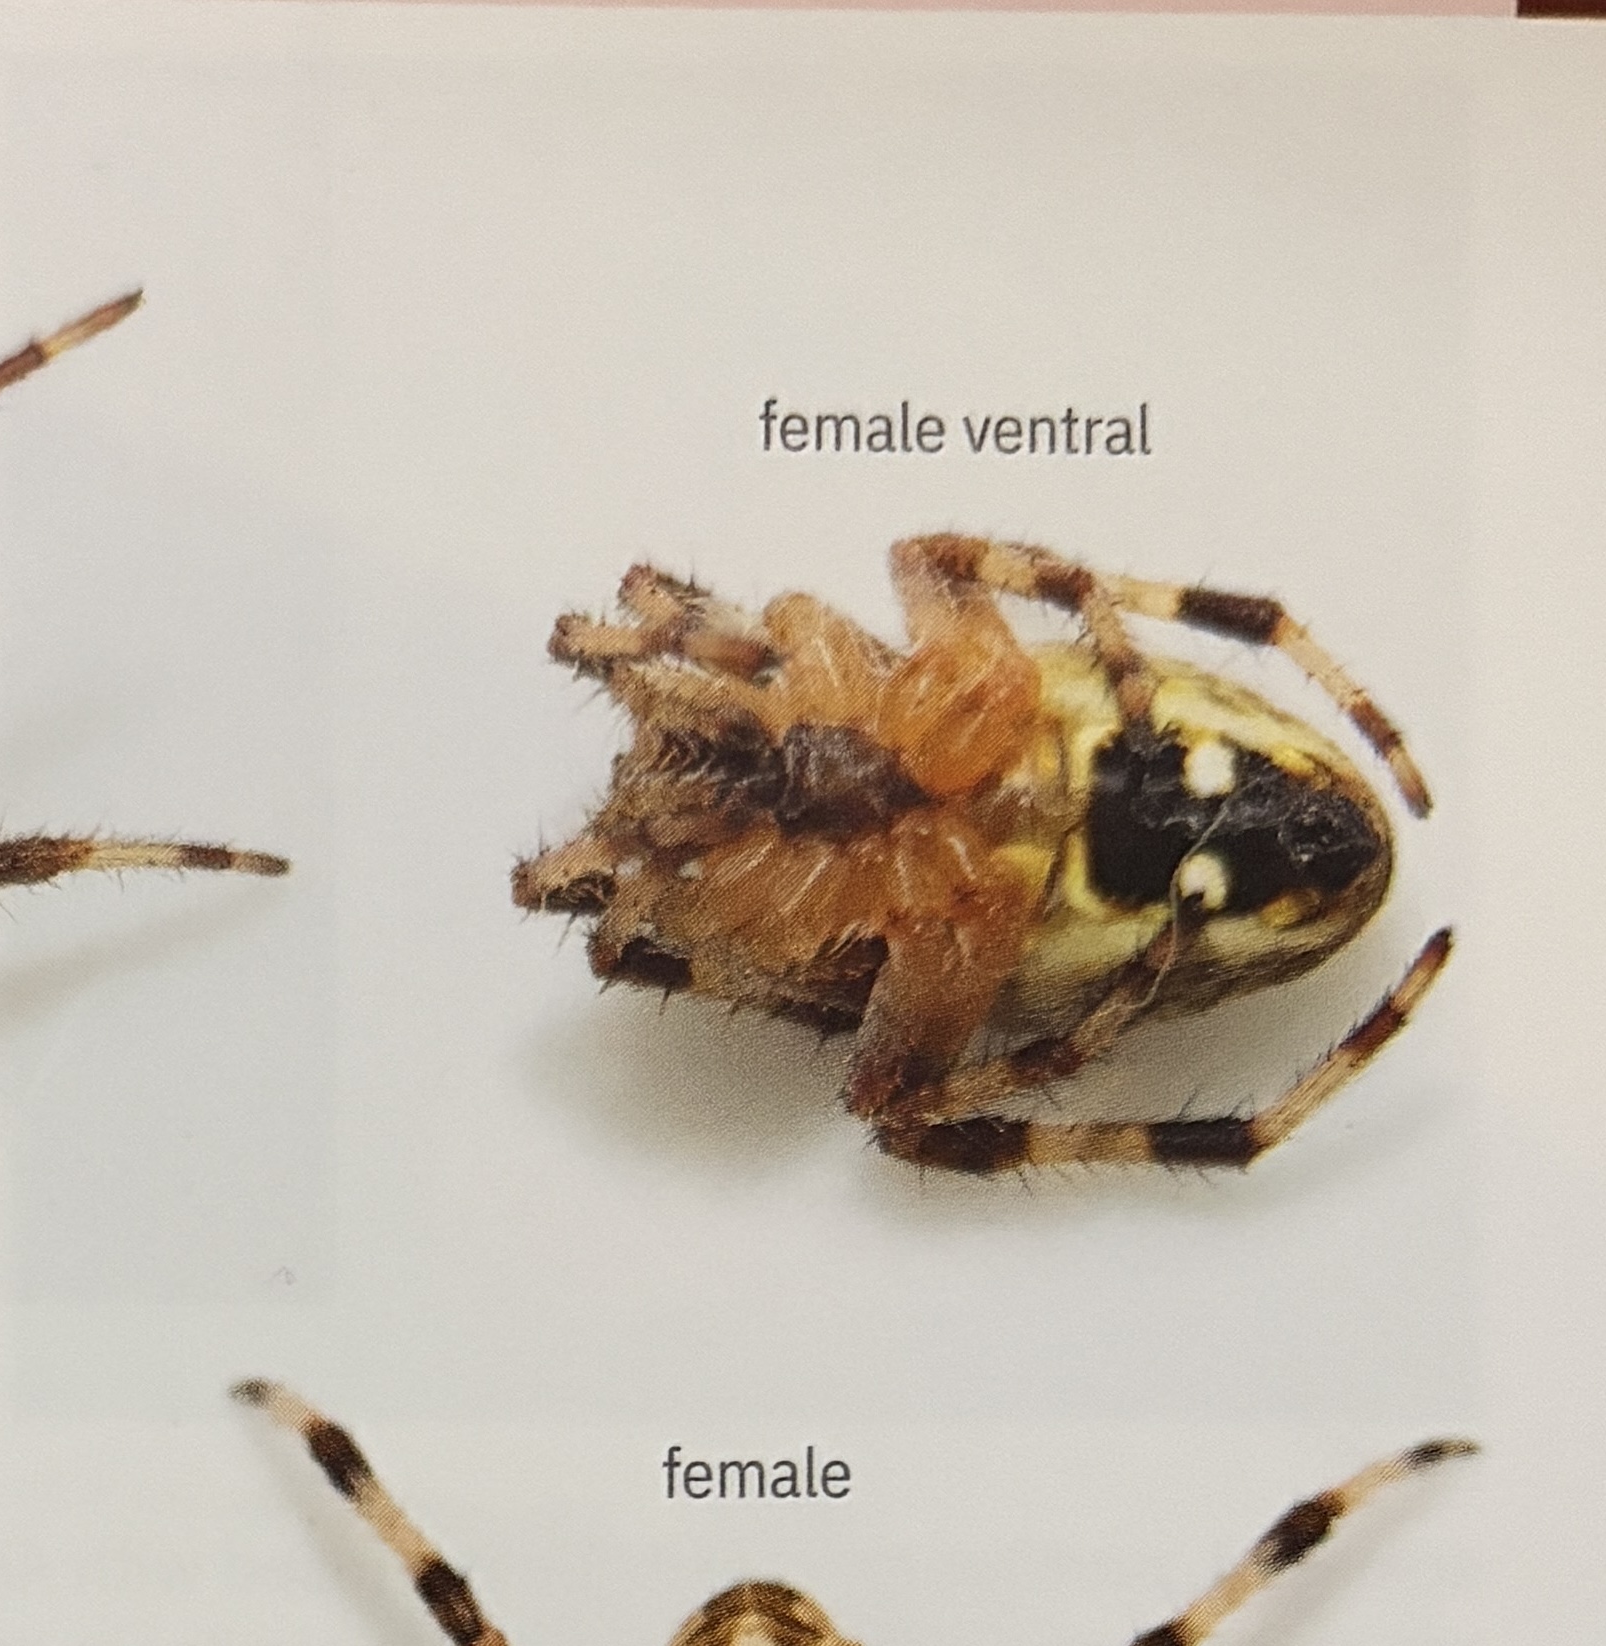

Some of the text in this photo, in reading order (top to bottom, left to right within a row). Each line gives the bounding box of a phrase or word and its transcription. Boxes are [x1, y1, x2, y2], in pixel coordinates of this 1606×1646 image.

[759, 398, 1151, 455] female ventral
[662, 1446, 851, 1499] female
